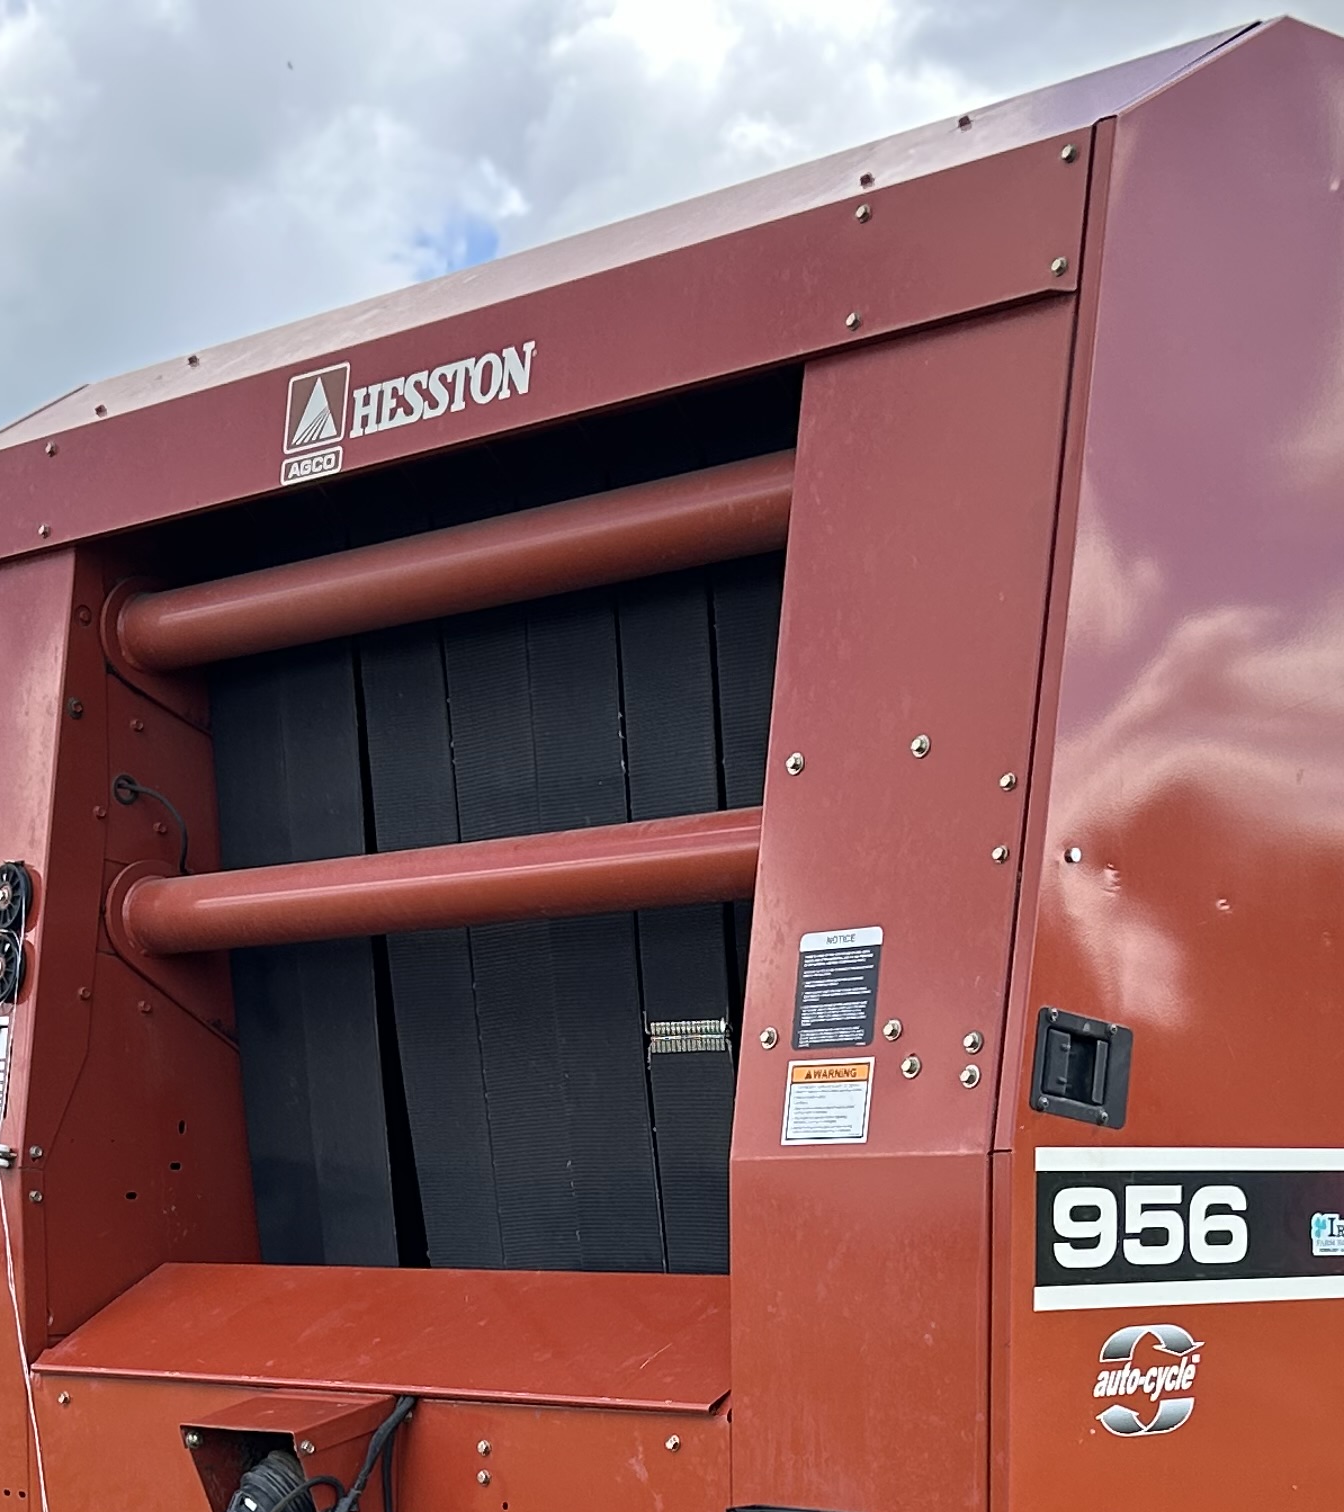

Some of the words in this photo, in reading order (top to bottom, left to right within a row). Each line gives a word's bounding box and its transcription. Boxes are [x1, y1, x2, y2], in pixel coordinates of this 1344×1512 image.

[349, 340, 536, 439] HESSTON
[287, 453, 337, 480] AGCO
[825, 932, 857, 945] NOTICE
[812, 1067, 858, 1080] WARNING
[1052, 1184, 1249, 1269] 956
[1093, 1355, 1197, 1402] auto-cycle
